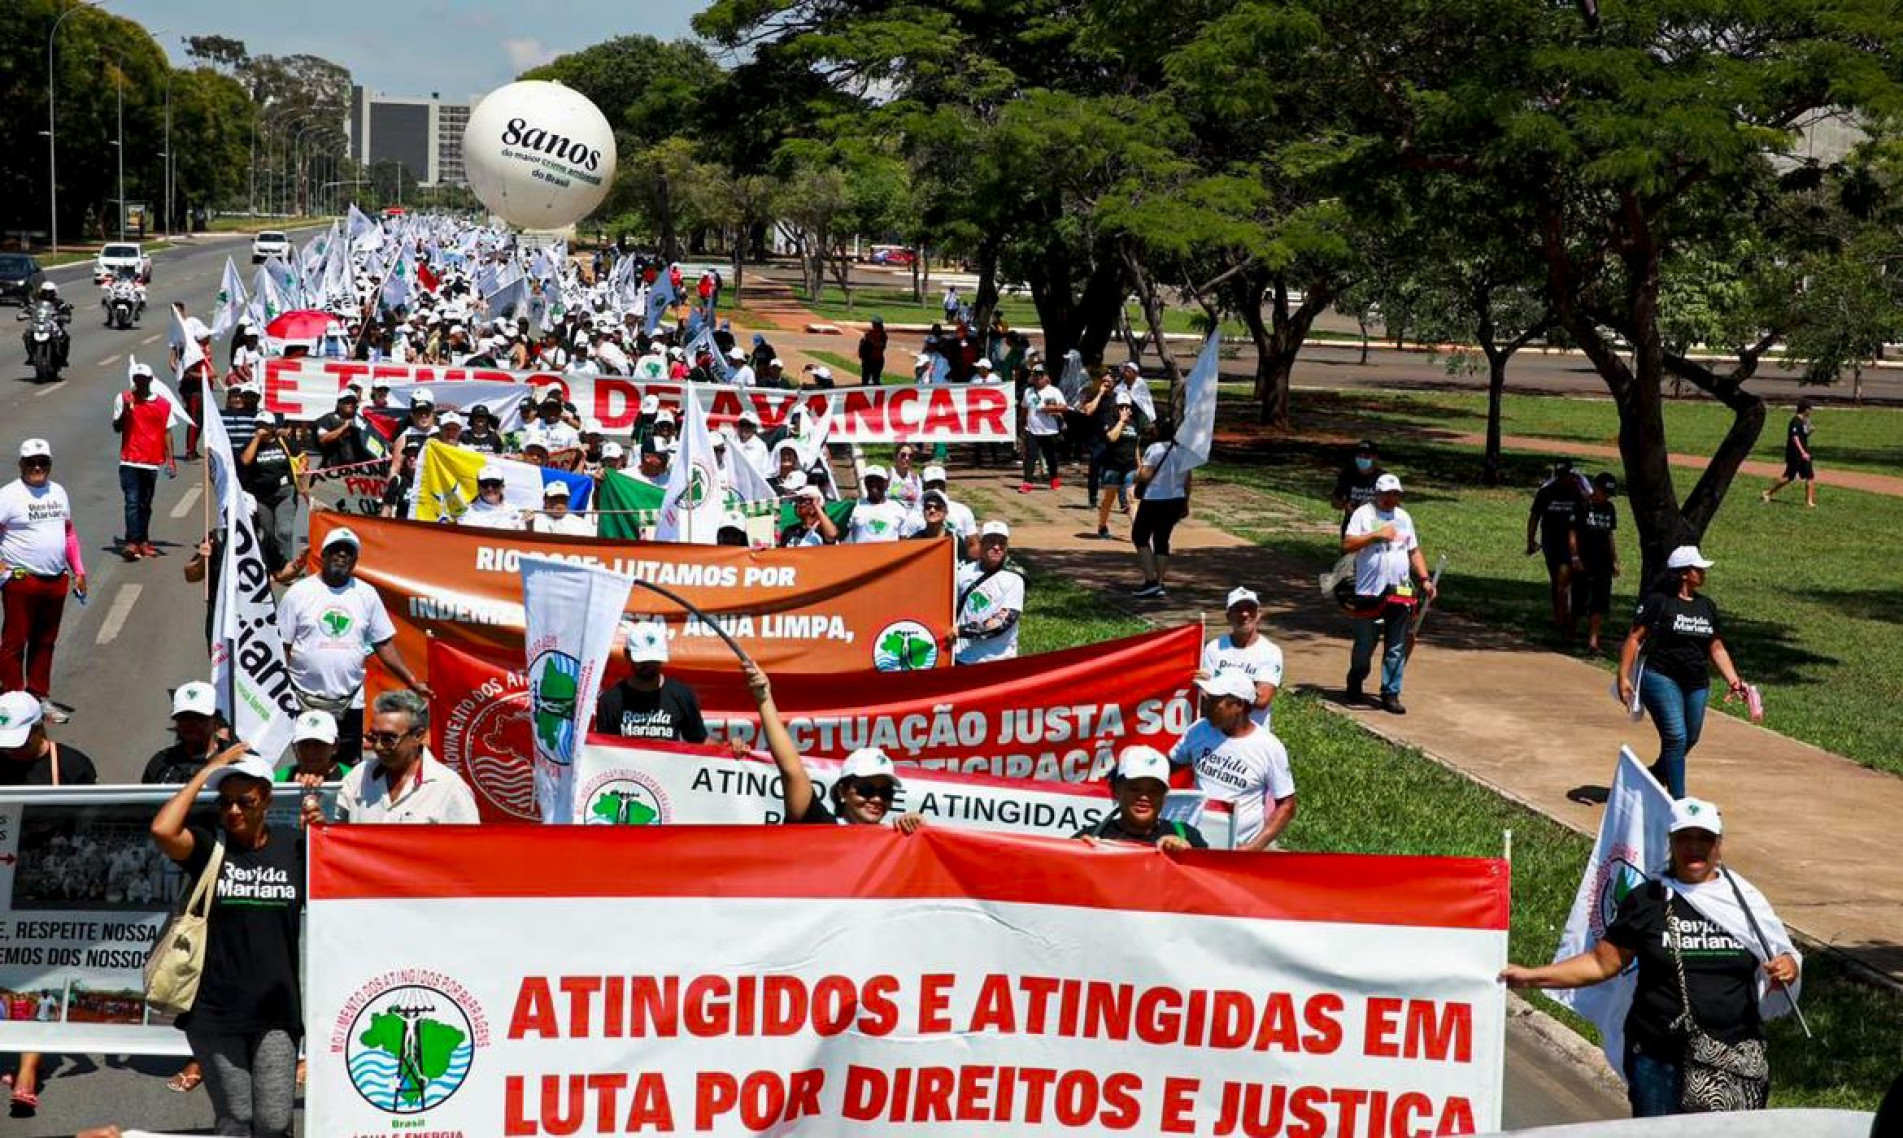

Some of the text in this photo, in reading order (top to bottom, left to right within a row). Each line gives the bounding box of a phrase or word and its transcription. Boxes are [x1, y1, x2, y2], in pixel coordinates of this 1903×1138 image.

[743, 567, 796, 587] POR
[761, 615, 855, 643] LIMPA,
[470, 677, 503, 702] DOS
[622, 710, 671, 724] Revida
[998, 702, 1125, 745] JUSTA
[1136, 690, 1192, 736] SÓ
[620, 722, 673, 738] Mariana
[1202, 747, 1248, 775] Revida
[919, 791, 1102, 830] ATINGIDAS
[224, 861, 288, 883] Revida
[217, 879, 296, 899] Mariana
[16, 922, 99, 941] RESPEITE
[102, 923, 157, 942] NOSSA
[47, 949, 81, 967] DOS
[507, 973, 1473, 1063] ATINGIDOS E ATINGIDAS EM
[503, 1072, 675, 1136] LUTA
[695, 1068, 824, 1132] POR
[842, 1064, 1143, 1131] DIREITOS
[1160, 1077, 1200, 1135] E
[392, 1119, 426, 1129] Brasil
